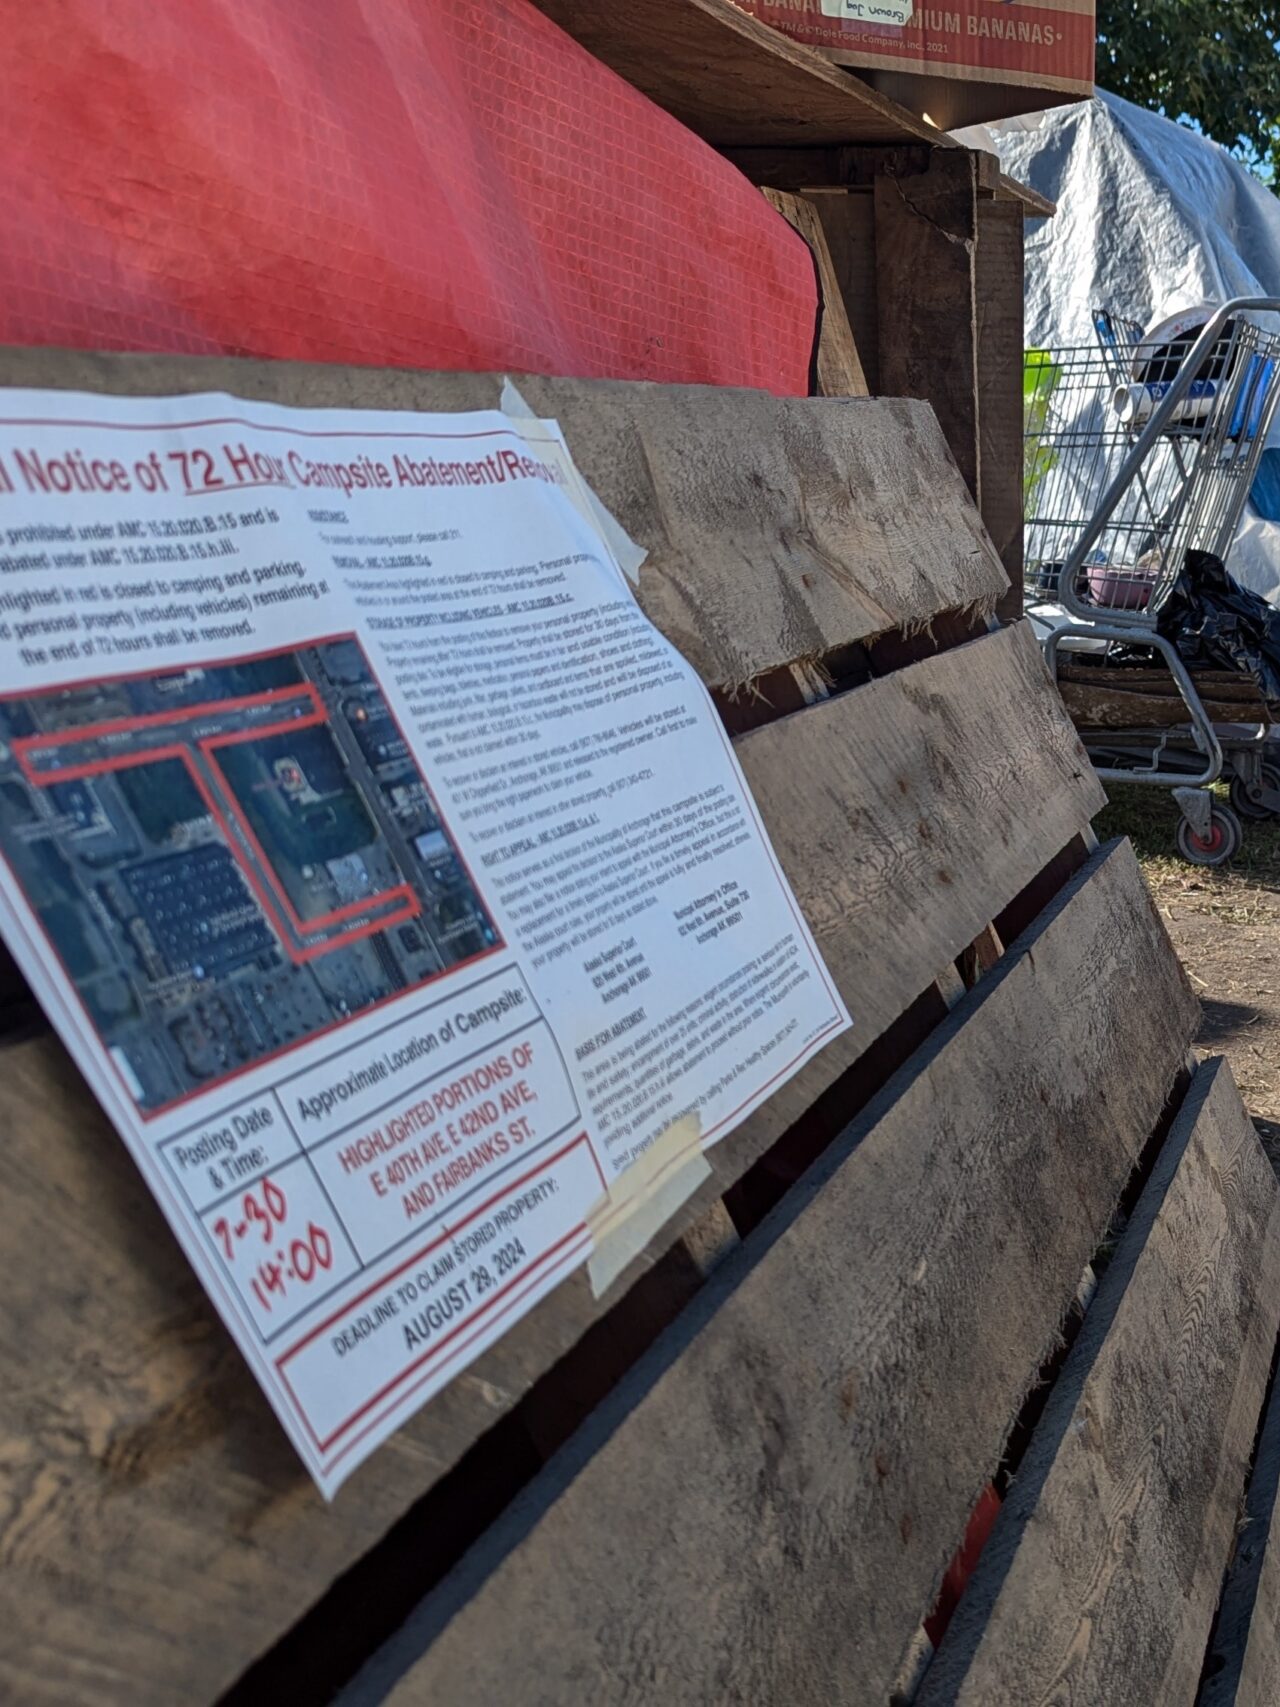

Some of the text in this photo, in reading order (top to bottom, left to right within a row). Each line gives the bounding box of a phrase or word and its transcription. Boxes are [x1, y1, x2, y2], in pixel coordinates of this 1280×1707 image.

[815, 26, 837, 40] Dole
[838, 30, 861, 42] Food
[926, 41, 949, 54] 2021
[868, 5, 905, 23] Brown
[906, 8, 1054, 46] MIUM BANANAS
[13, 448, 131, 493] Notice
[134, 451, 169, 493] of
[168, 449, 224, 490] 72
[222, 443, 290, 483] Hour
[287, 450, 393, 499] Campsite
[239, 507, 266, 527] and
[265, 507, 280, 523] is
[14, 612, 79, 641] personal
[81, 609, 135, 633] property
[194, 592, 253, 617] vehicles)
[252, 581, 320, 606] remaining
[113, 579, 156, 599] closed
[156, 577, 171, 596] to
[171, 572, 225, 595] camping
[225, 566, 252, 587] and
[49, 639, 80, 661] end
[112, 635, 153, 653] hours
[152, 627, 181, 648] shall
[180, 626, 200, 645] be
[296, 987, 528, 1122] Approximate Location of Campsite:
[337, 1041, 534, 1174] HIGHLIGHTED PORTIONS OF
[173, 1107, 275, 1170] Posting Date
[206, 1145, 270, 1191] & Time:
[369, 1079, 539, 1198] E 40TH AVE, E 42ND AVE,
[401, 1115, 536, 1221] AND FAIRBANKS ST.
[214, 1175, 287, 1261] 7-30
[251, 1220, 333, 1313] 14:00
[331, 1176, 561, 1359] DEADLINE TO CLAIM STORED PROPERTY:
[401, 1235, 527, 1351] AUGUST 29, 2024
